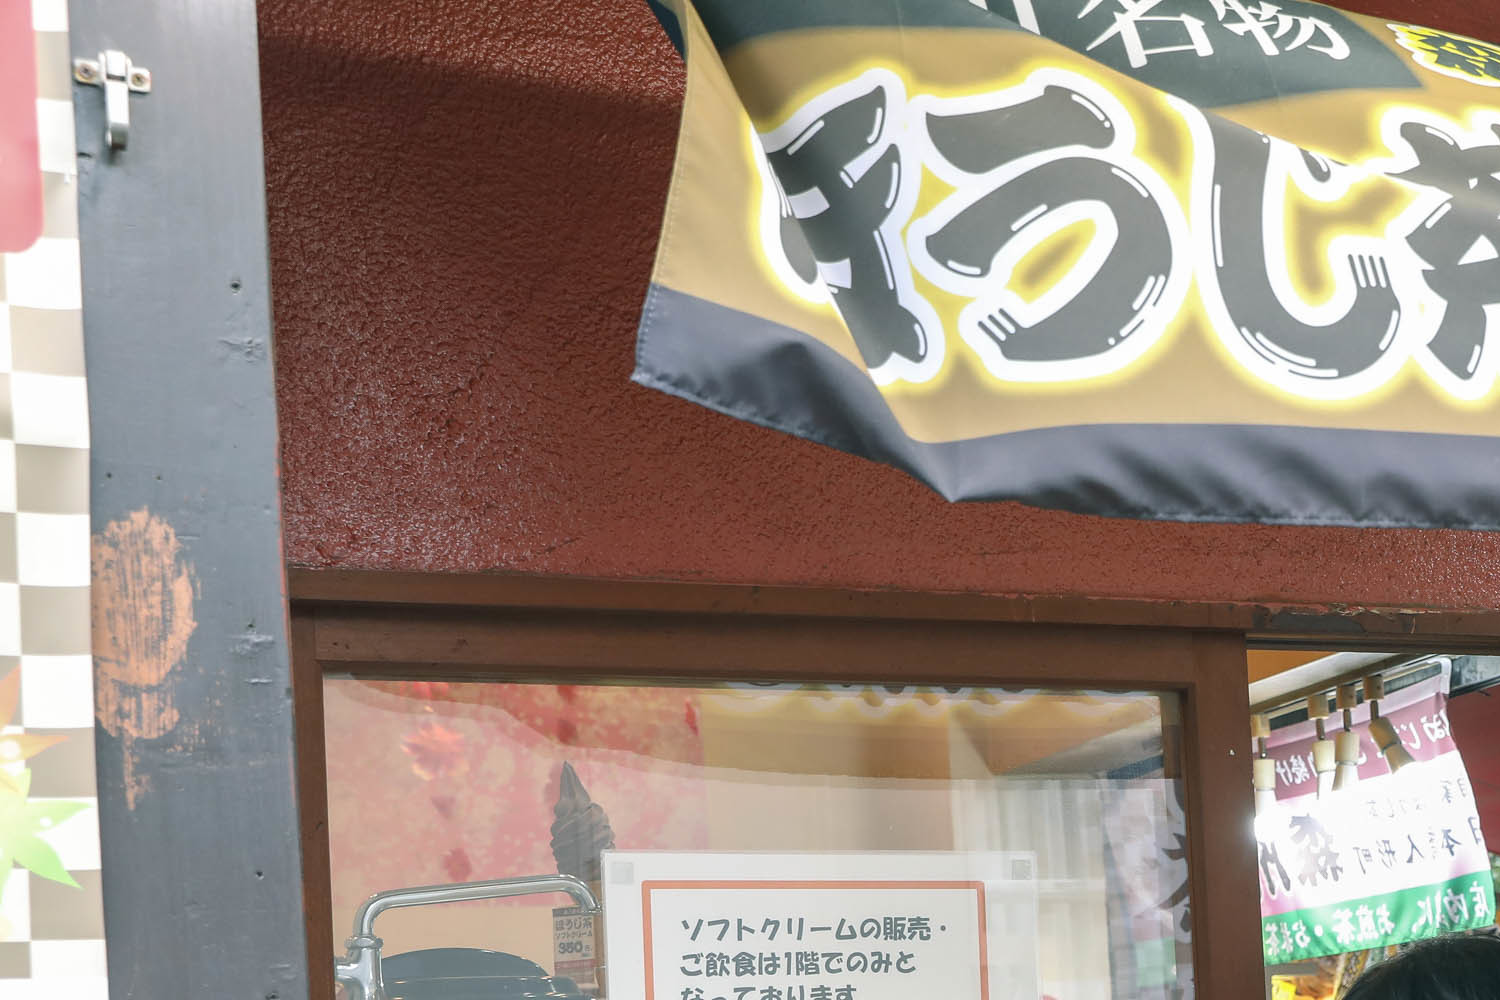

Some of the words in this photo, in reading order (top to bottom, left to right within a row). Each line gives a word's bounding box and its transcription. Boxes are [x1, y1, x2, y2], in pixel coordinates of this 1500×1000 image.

[679, 949, 917, 979] ご飲食は1階でのみと
